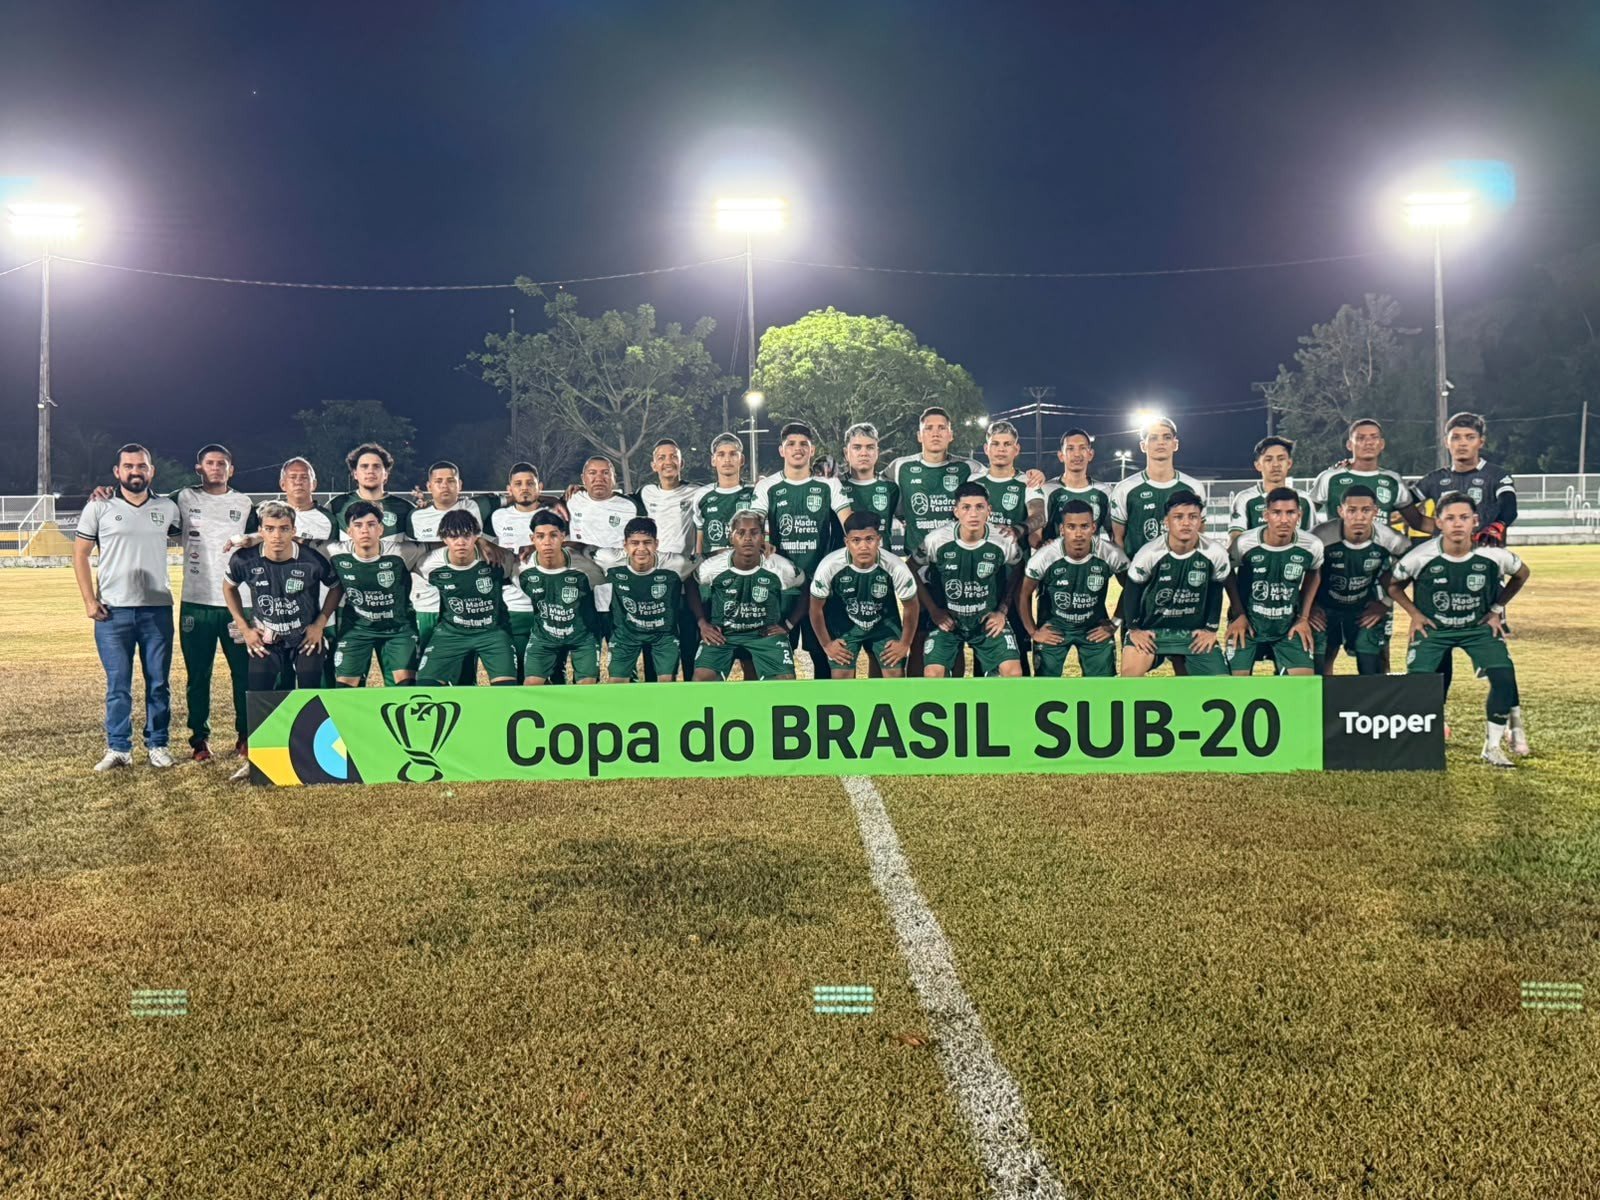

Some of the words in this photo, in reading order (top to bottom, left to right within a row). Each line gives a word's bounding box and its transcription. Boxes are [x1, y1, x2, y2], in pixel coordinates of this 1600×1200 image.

[930, 497, 956, 505] Madre
[365, 593, 393, 601] Madre
[964, 590, 989, 598] Tereza
[465, 604, 494, 613] Tereza
[639, 602, 664, 610] Madre
[640, 607, 666, 615] Tereza
[1339, 711, 1437, 739] Topper
[507, 709, 660, 777] Copa
[680, 707, 755, 763] do
[772, 702, 1011, 760] BRASIL
[1034, 698, 1281, 759] SUB-20
